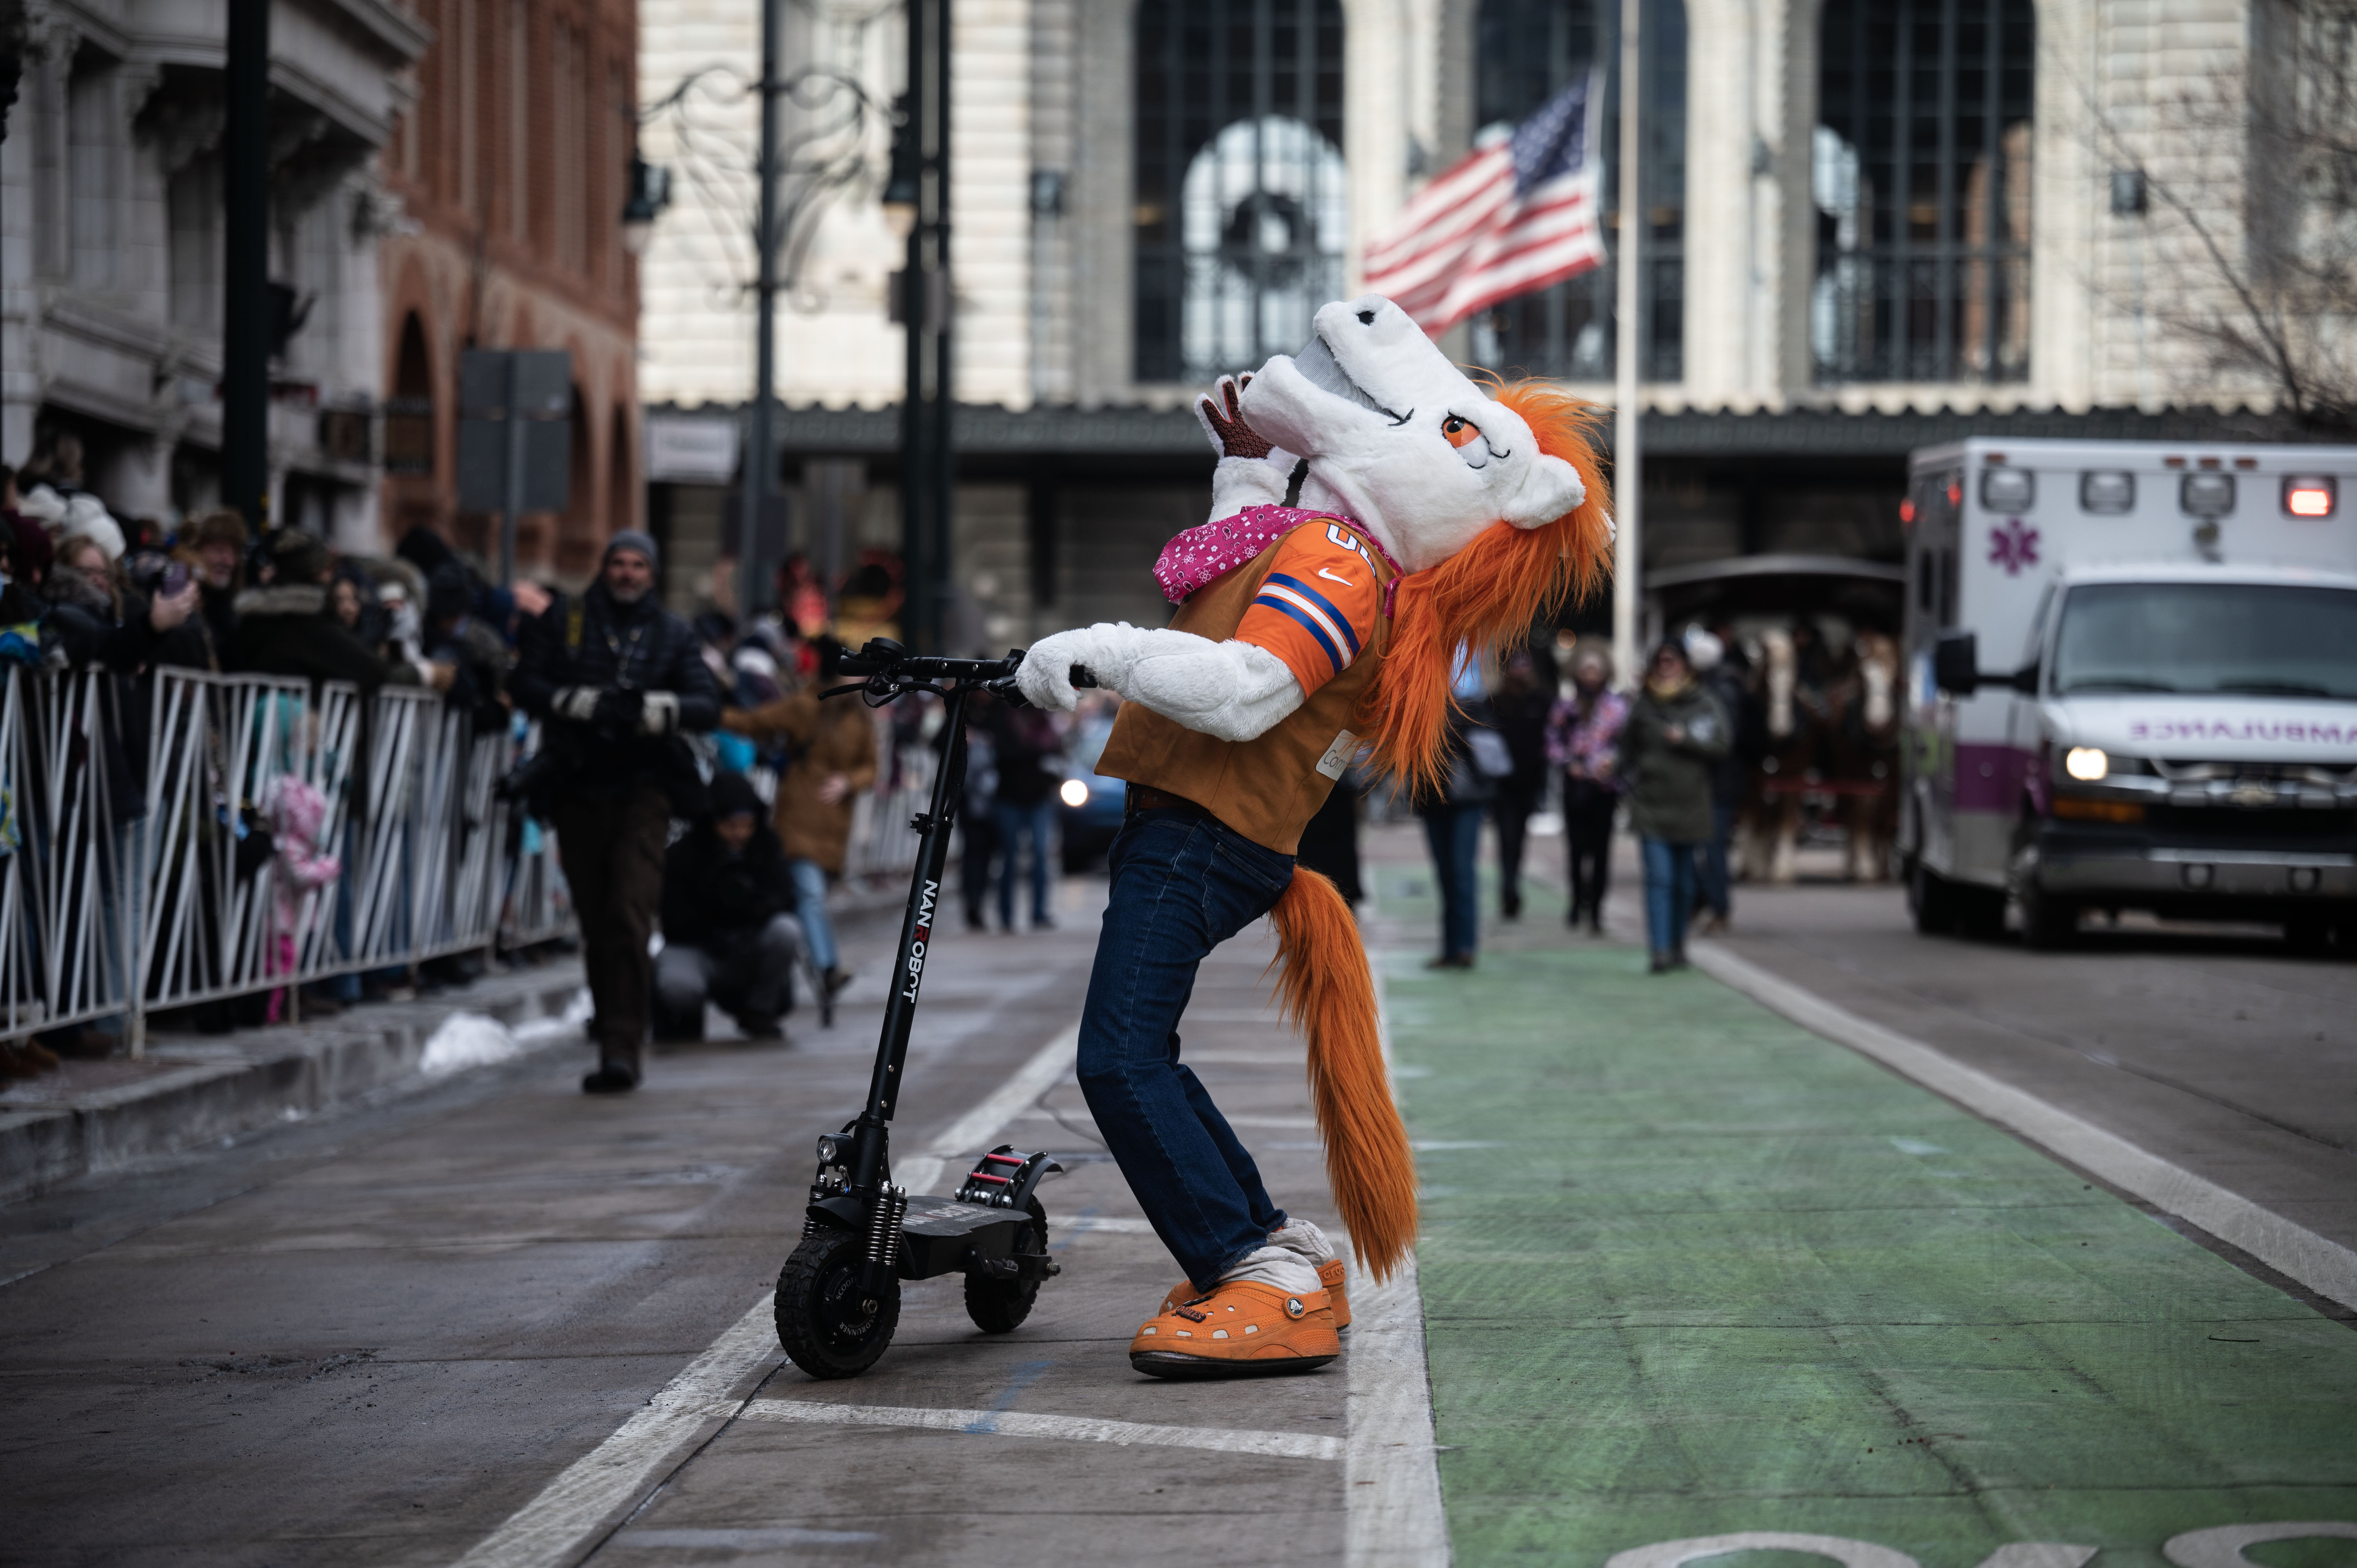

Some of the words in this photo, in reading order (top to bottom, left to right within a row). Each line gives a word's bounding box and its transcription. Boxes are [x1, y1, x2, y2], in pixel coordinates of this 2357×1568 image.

[1323, 1264, 1345, 1280] croc
[836, 1276, 857, 1301] SCOOT
[1177, 1306, 1205, 1319] MILES
[839, 1315, 876, 1336] ADRUNNER
